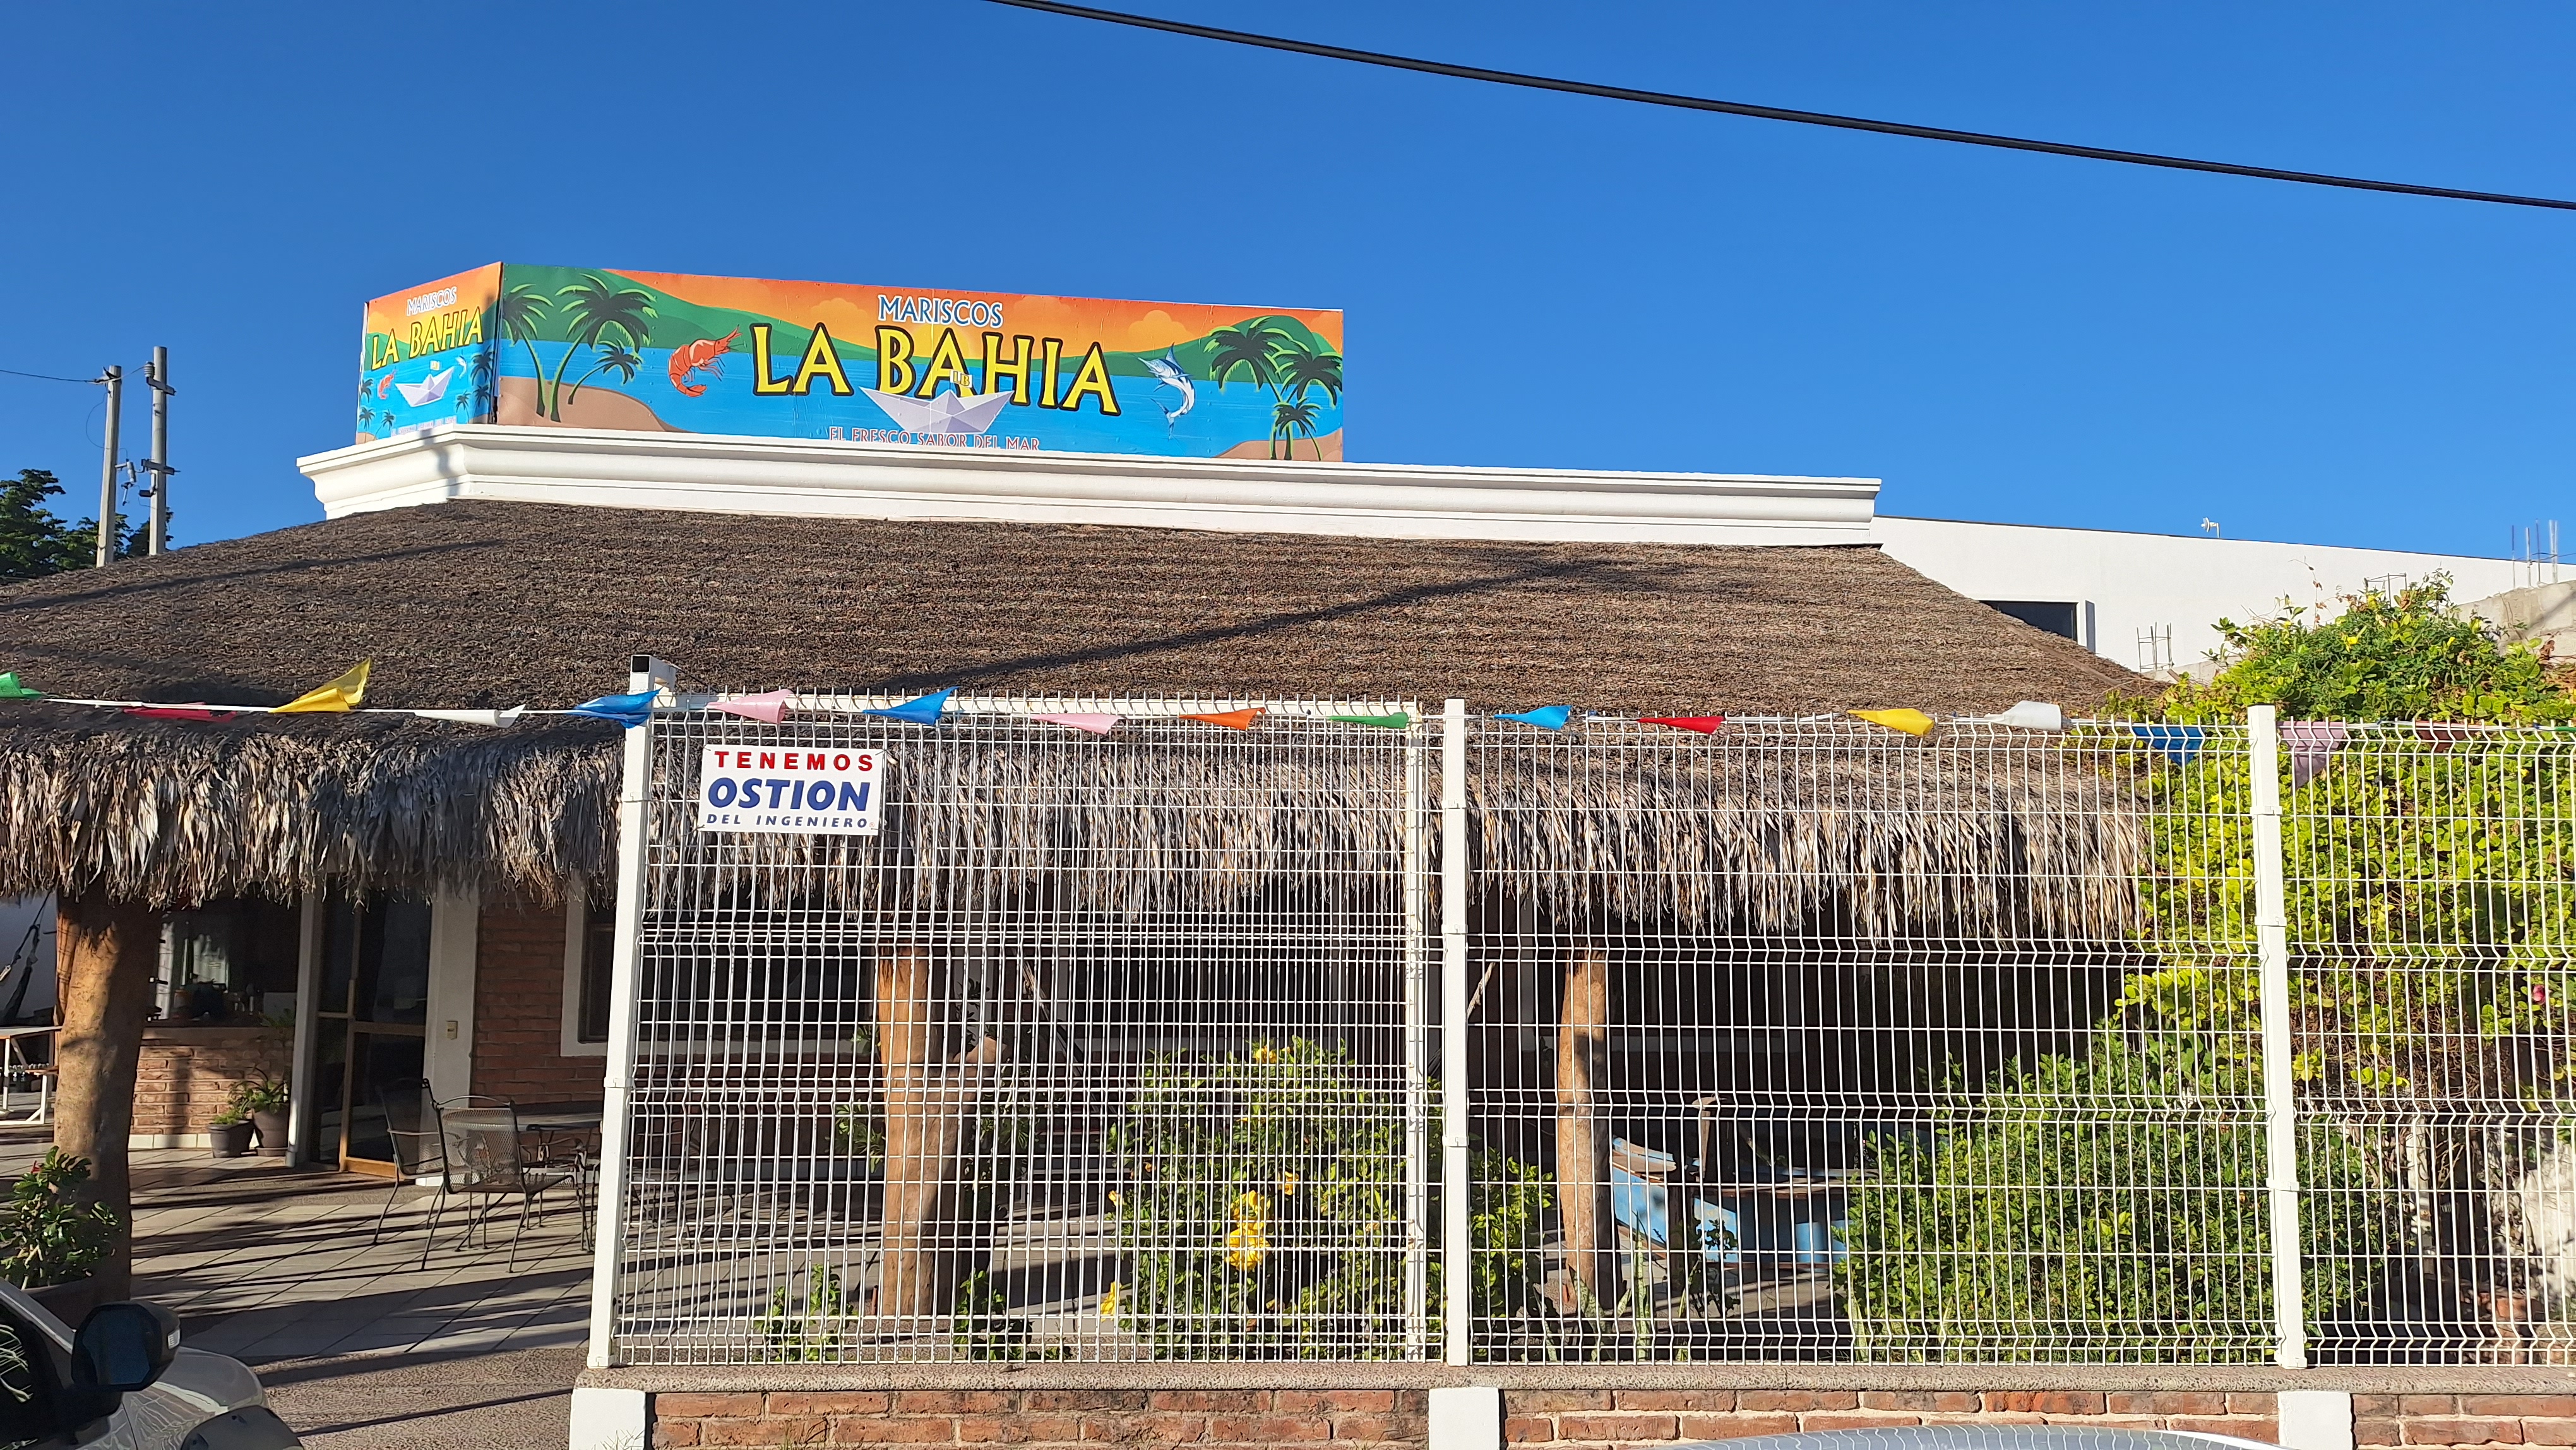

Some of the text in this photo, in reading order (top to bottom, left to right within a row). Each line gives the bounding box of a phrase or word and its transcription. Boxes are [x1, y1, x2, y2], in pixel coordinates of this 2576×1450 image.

[406, 286, 458, 316] MARISCOS
[878, 294, 1003, 328] MARISCOS
[371, 306, 484, 371] LA BAHIA
[749, 323, 1121, 416] LA BAHIA
[828, 426, 1041, 451] EL FRESCO SABOR DEL MAR
[714, 750, 873, 772] TENEMOS
[708, 777, 871, 812] OSTION
[707, 813, 868, 828] DEL INGENIERO
